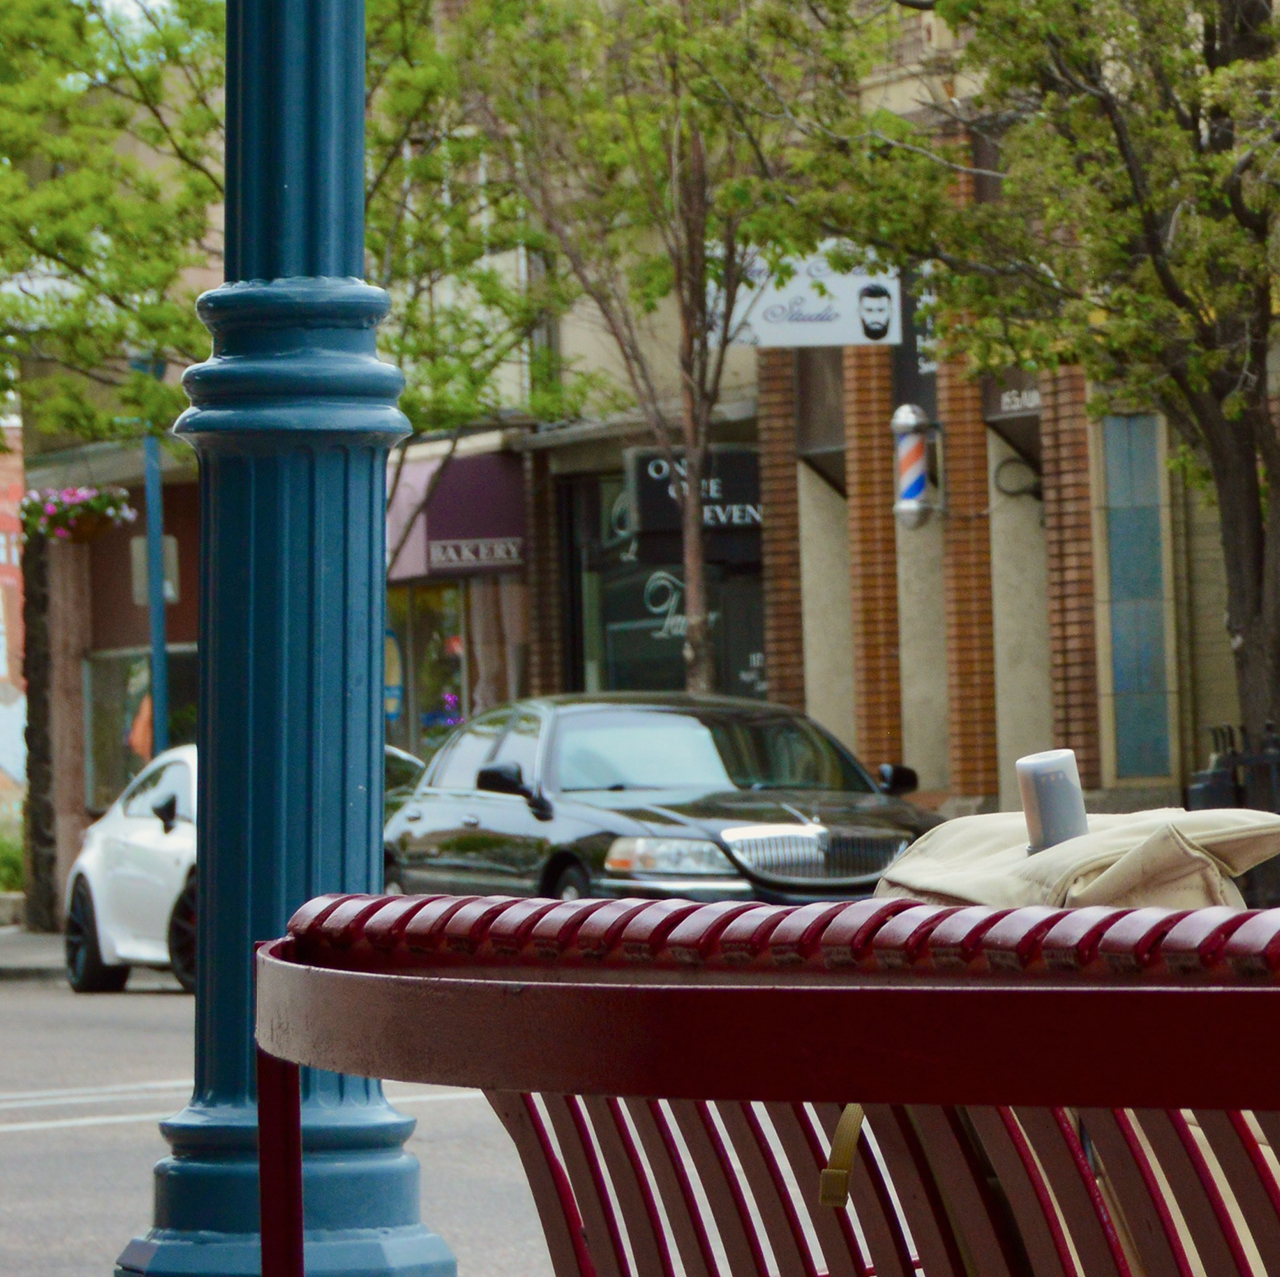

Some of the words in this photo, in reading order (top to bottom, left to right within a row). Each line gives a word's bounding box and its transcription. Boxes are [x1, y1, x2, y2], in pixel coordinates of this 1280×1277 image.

[762, 295, 840, 324] Studio
[648, 458, 689, 480] ON
[702, 503, 763, 525] EVEN
[430, 542, 520, 564] BAKERY
